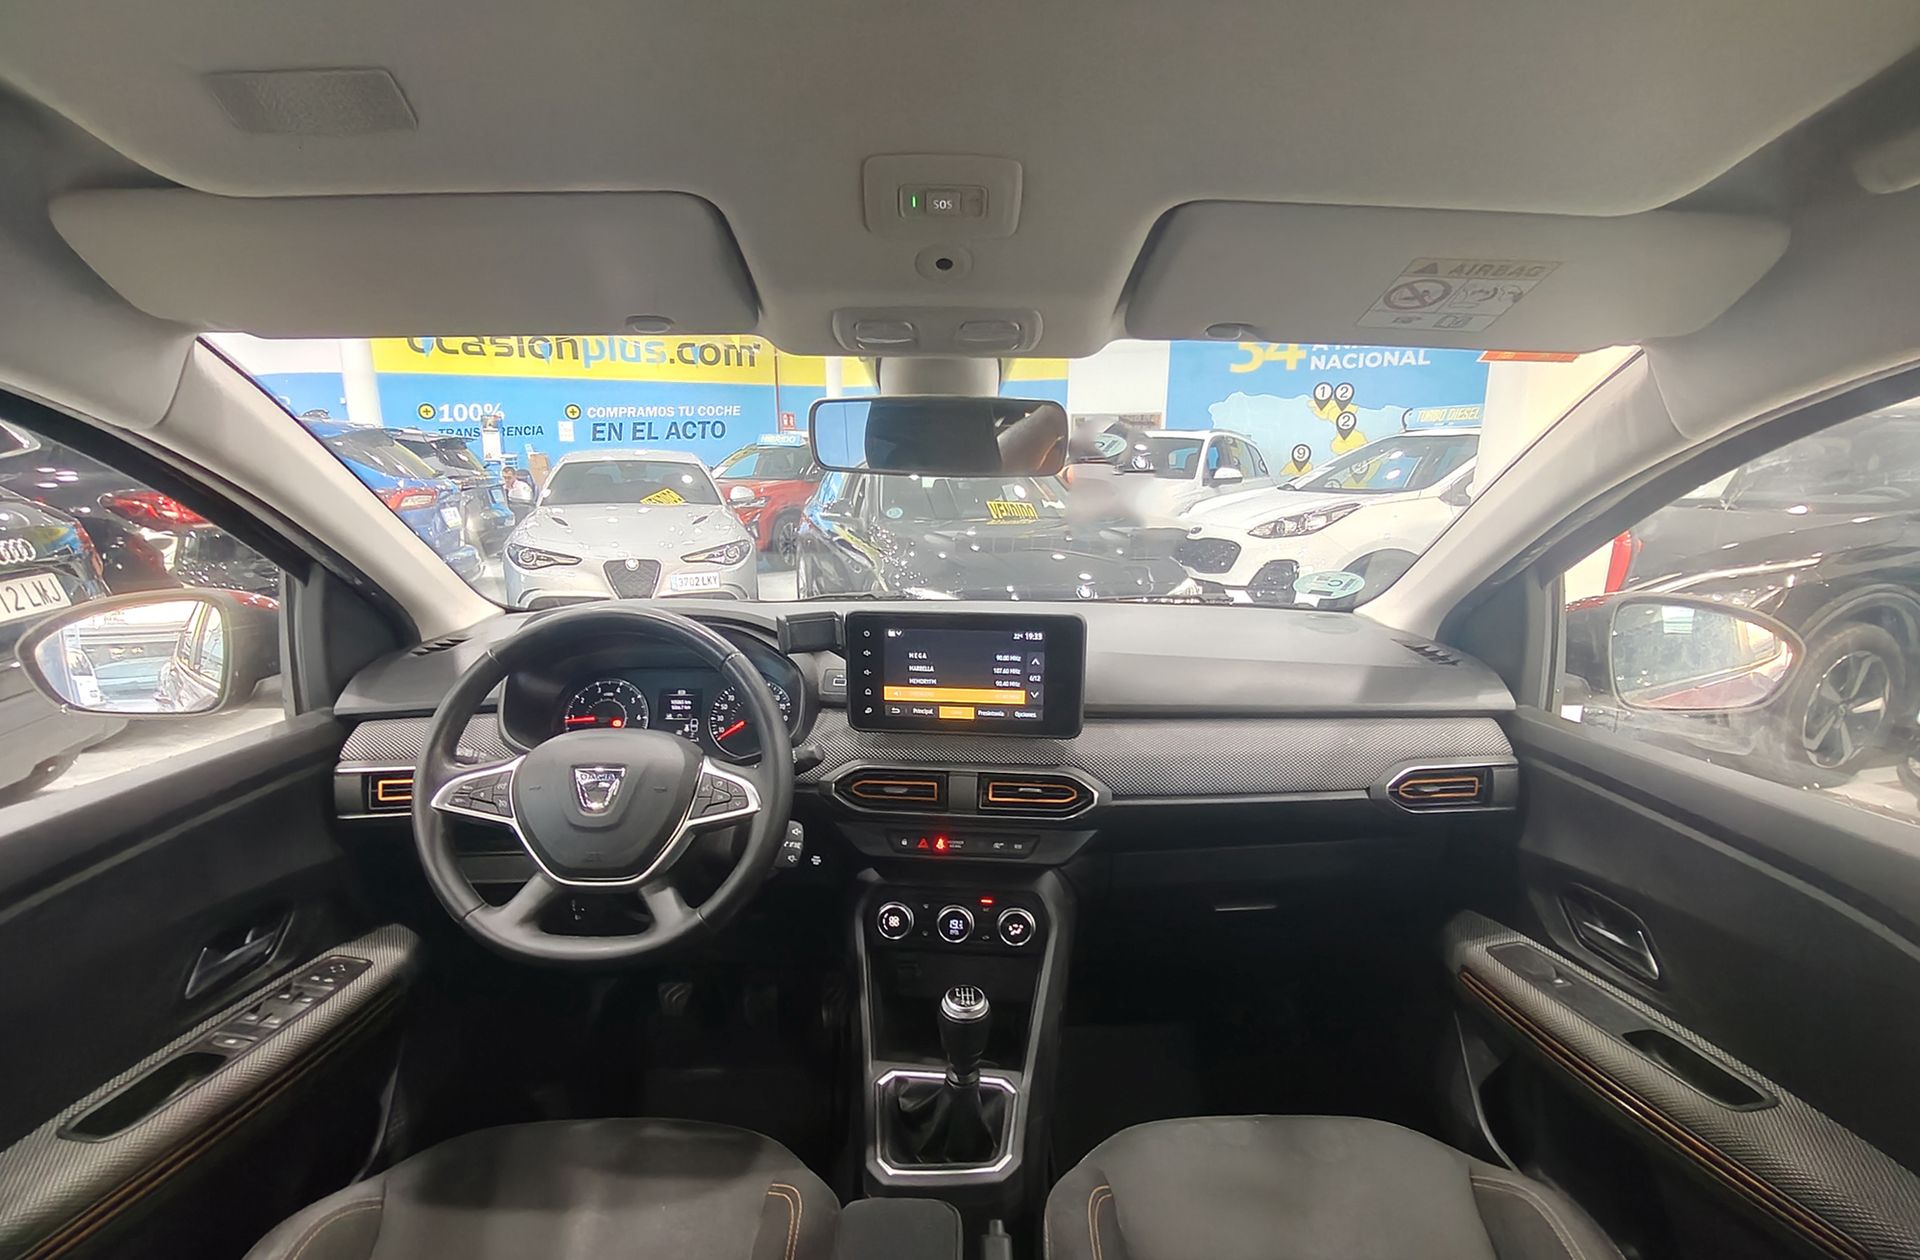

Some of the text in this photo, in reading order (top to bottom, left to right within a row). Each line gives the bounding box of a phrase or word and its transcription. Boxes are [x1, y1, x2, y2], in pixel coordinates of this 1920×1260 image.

[933, 200, 953, 210] SOS
[1447, 263, 1546, 277] AIRBAG
[1310, 349, 1431, 371] NACIONAL
[1319, 386, 1328, 398] 1
[1339, 386, 1349, 398] 2
[438, 403, 505, 423] 100%
[587, 405, 741, 419] COMPRAMOS TU COCHE
[1447, 406, 1481, 421] DIESEL
[1341, 415, 1351, 428] 2
[592, 420, 727, 442] EN EL ACTO
[1296, 448, 1305, 461] 9
[988, 502, 1037, 520] VENDIDO
[678, 575, 718, 587] 3702 LKY
